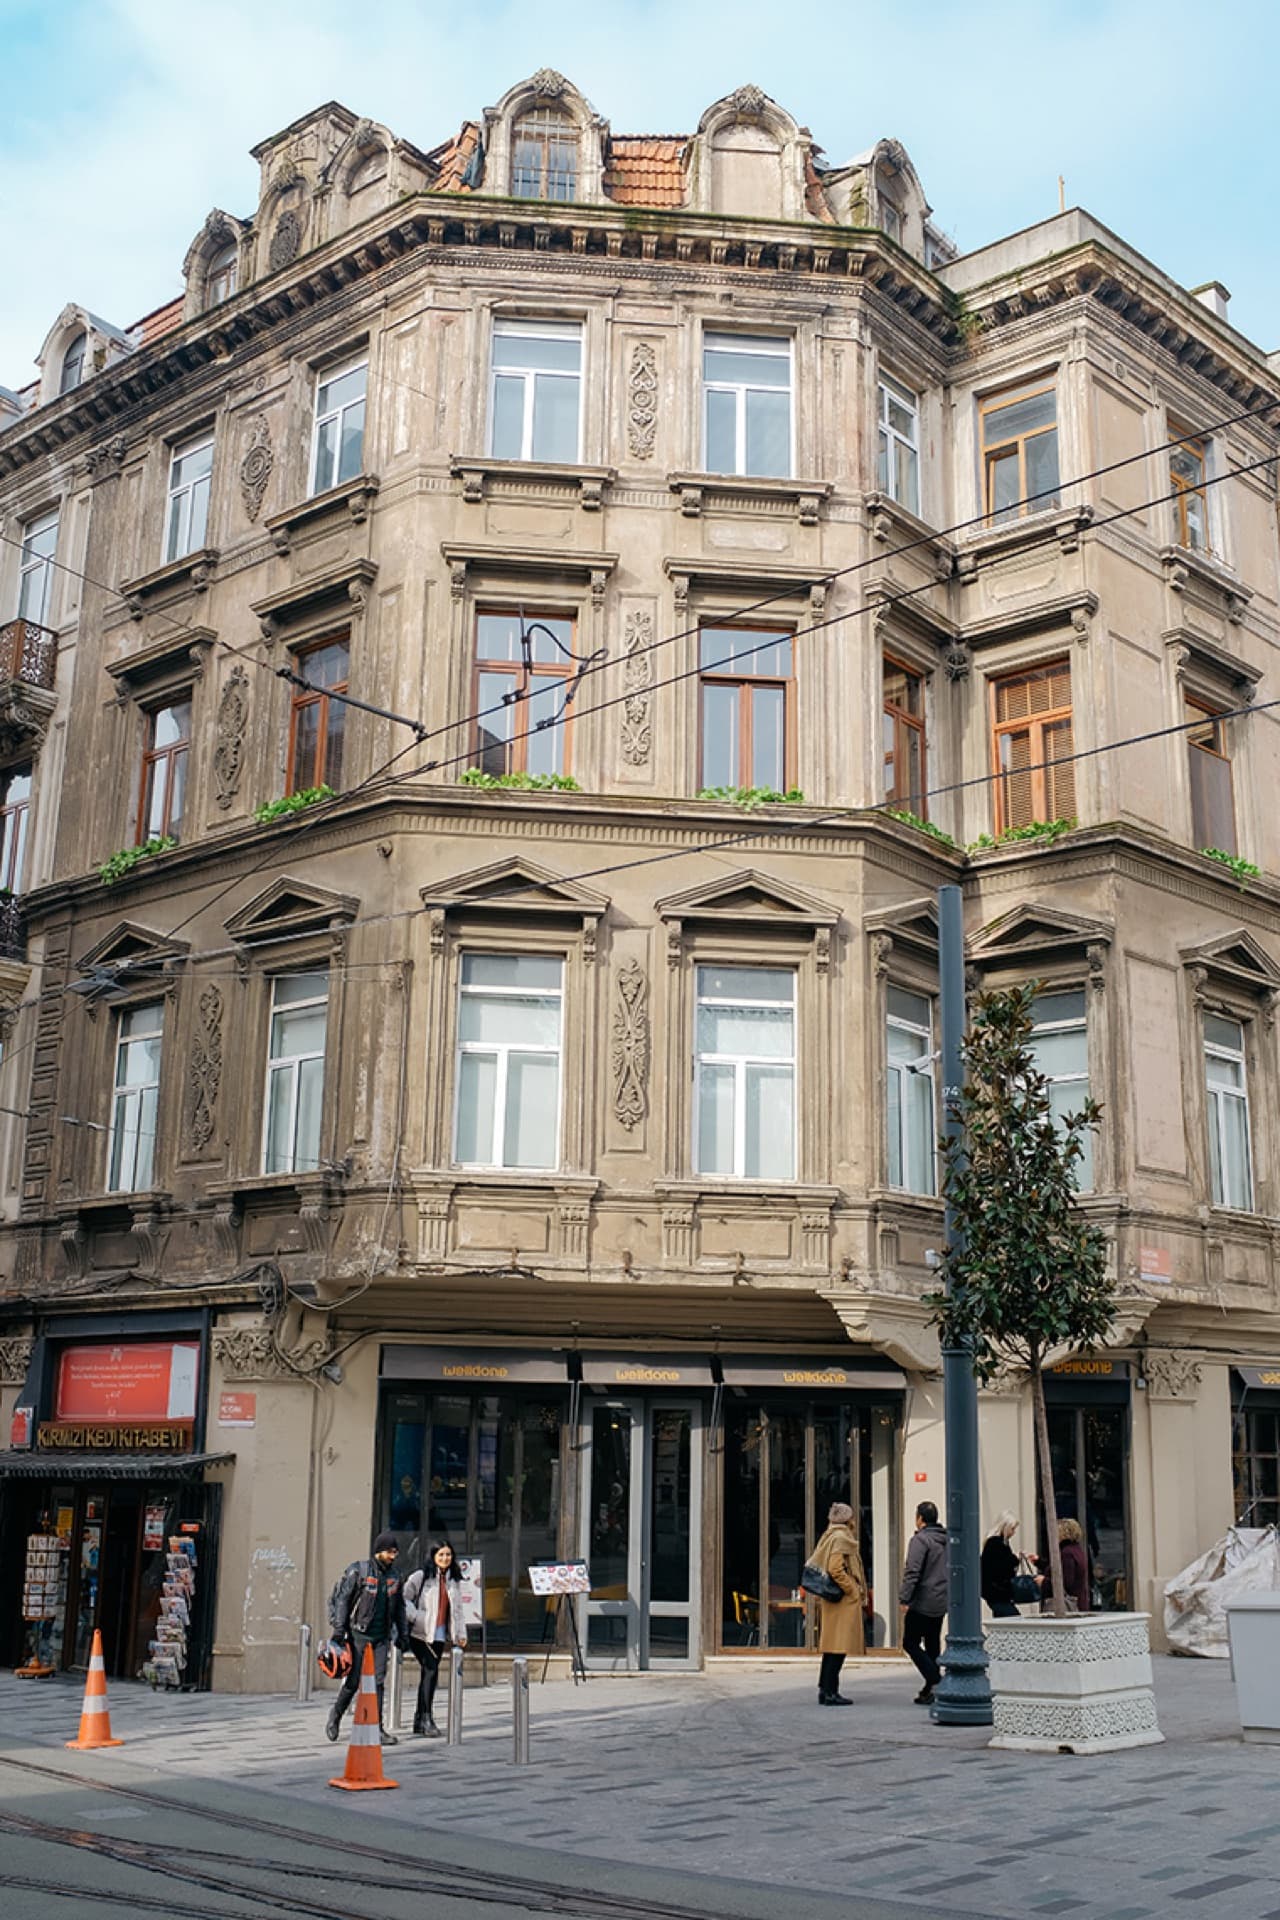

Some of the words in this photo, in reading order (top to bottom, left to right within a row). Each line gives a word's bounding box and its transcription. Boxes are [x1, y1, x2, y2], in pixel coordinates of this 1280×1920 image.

[442, 1365, 508, 1377] welldone
[615, 1368, 680, 1380] welldone
[784, 1371, 847, 1383] welldone
